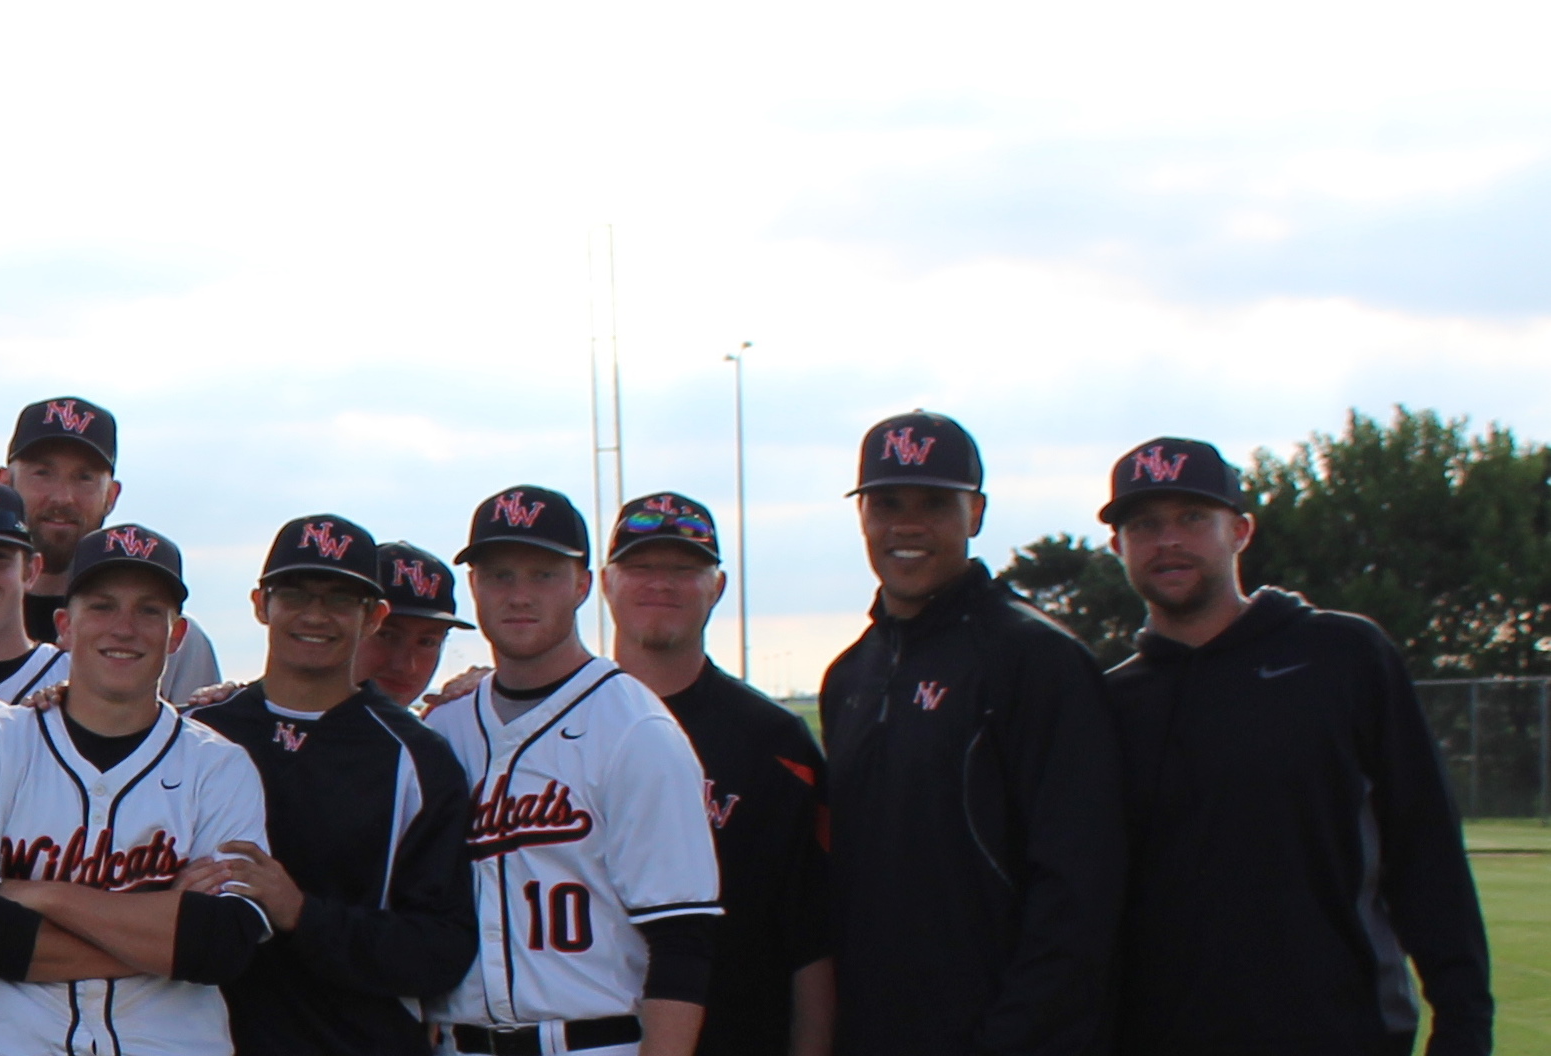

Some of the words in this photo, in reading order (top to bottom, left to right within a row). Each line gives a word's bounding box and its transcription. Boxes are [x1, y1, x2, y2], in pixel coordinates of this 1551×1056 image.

[41, 400, 96, 434] NW
[880, 427, 937, 466] NW
[1130, 446, 1189, 484] NW
[490, 491, 546, 528] NW
[104, 526, 158, 559] NW
[298, 522, 353, 561] NW
[391, 559, 441, 600] NW
[1, 825, 190, 893] Wildcats
[523, 880, 594, 953] 10
